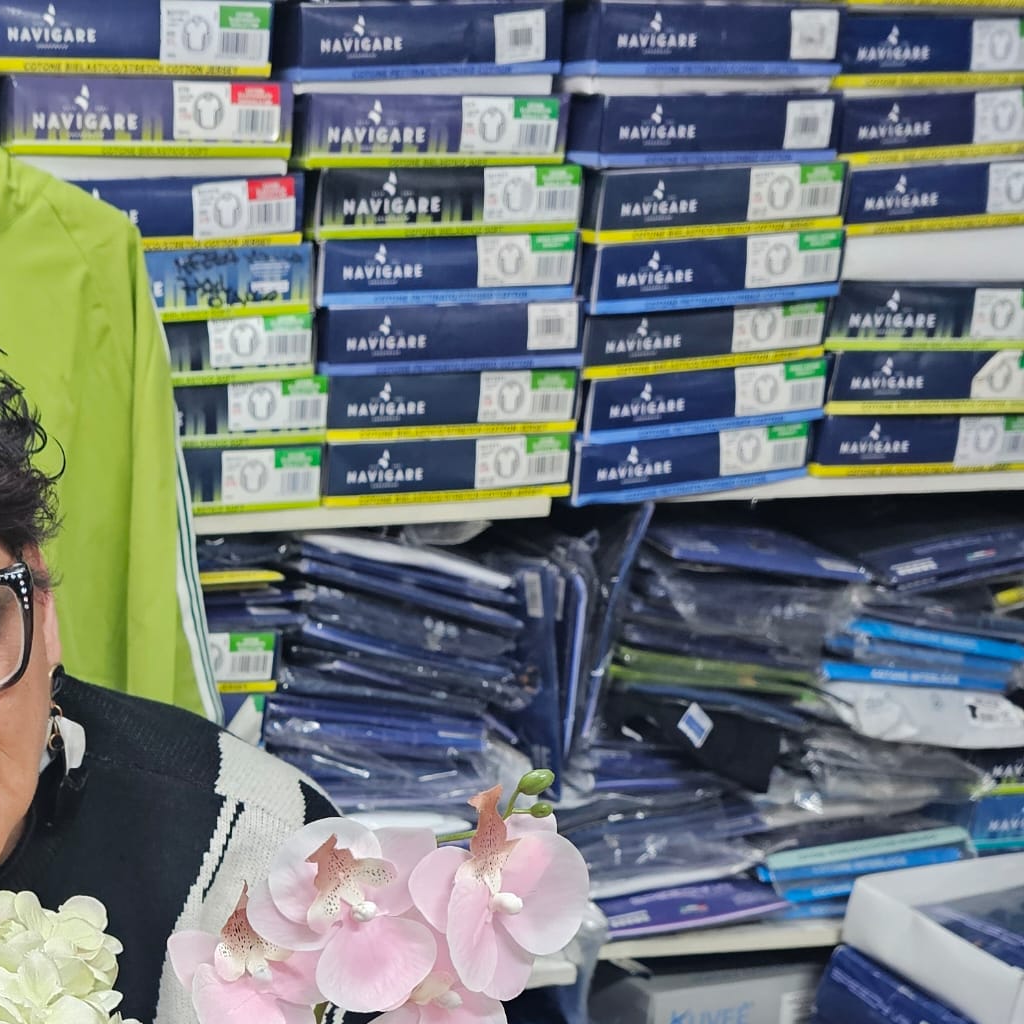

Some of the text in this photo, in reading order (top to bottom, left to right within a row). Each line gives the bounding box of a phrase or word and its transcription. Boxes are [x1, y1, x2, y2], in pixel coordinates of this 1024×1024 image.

[7, 27, 97, 44] NAVIGARE
[617, 33, 698, 48] NAVIGARE
[320, 37, 403, 54] NAVIGARE
[857, 45, 931, 61] NAVIGARE
[32, 112, 139, 131] NAVIGARE
[858, 121, 932, 139] NAVIGARE
[328, 126, 426, 144] NAVIGARE
[619, 124, 696, 140] NAVIGARE
[343, 196, 441, 215] NAVIGARE
[620, 199, 698, 217] NAVIGARE
[864, 192, 939, 211] NAVIGARE
[342, 264, 424, 281] NAVIGARE
[616, 269, 694, 288] NAVIGARE
[848, 313, 937, 329] NAVIGARE
[346, 335, 427, 352] NAVIGARE
[605, 334, 681, 354] NAVIGARE
[850, 376, 924, 389] NAVIGARE
[347, 401, 426, 417] NAVIGARE
[609, 398, 686, 418] NAVIGARE
[839, 439, 911, 455] NAVIGARE
[346, 467, 424, 484] NAVIGARE
[596, 460, 672, 481] NAVIGARE
[992, 763, 1024, 777] NAV
